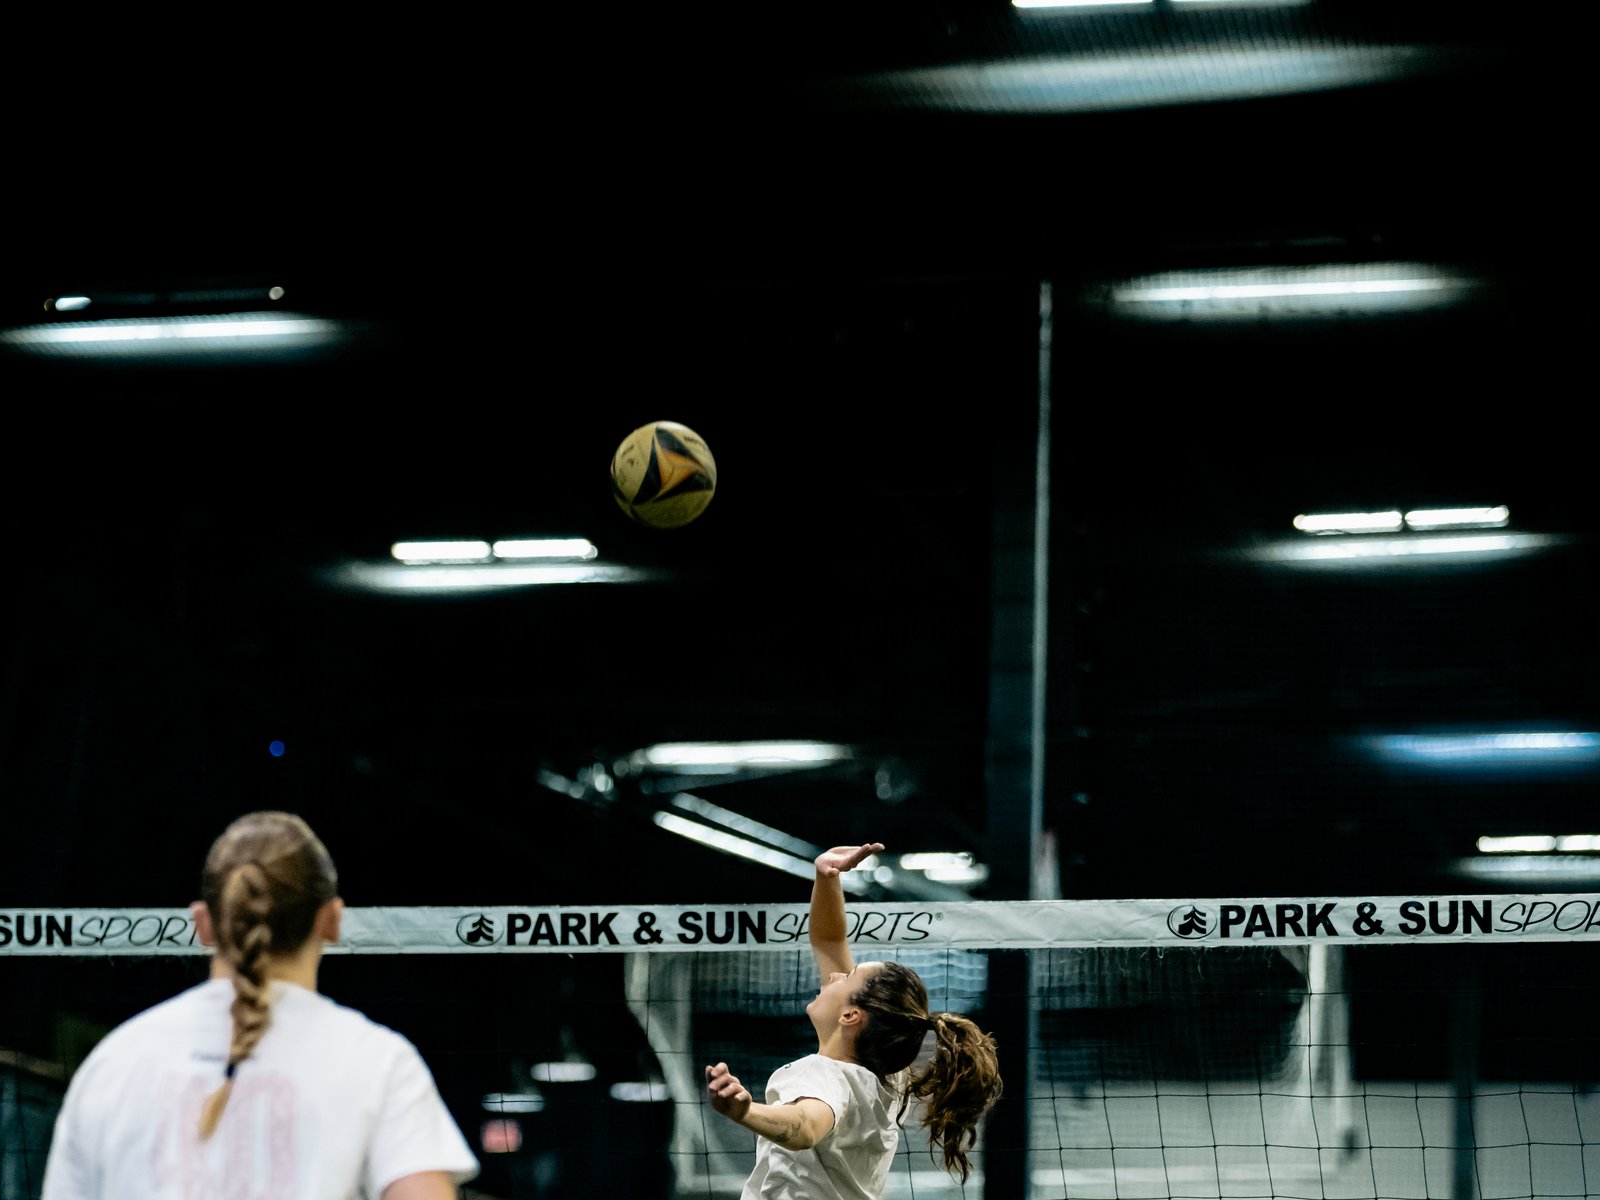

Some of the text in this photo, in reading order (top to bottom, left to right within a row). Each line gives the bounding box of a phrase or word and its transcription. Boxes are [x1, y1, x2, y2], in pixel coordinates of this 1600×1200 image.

[506, 912, 620, 946] PARK
[633, 911, 664, 945] &
[1219, 902, 1339, 938] PARK
[1352, 901, 1385, 936] &
